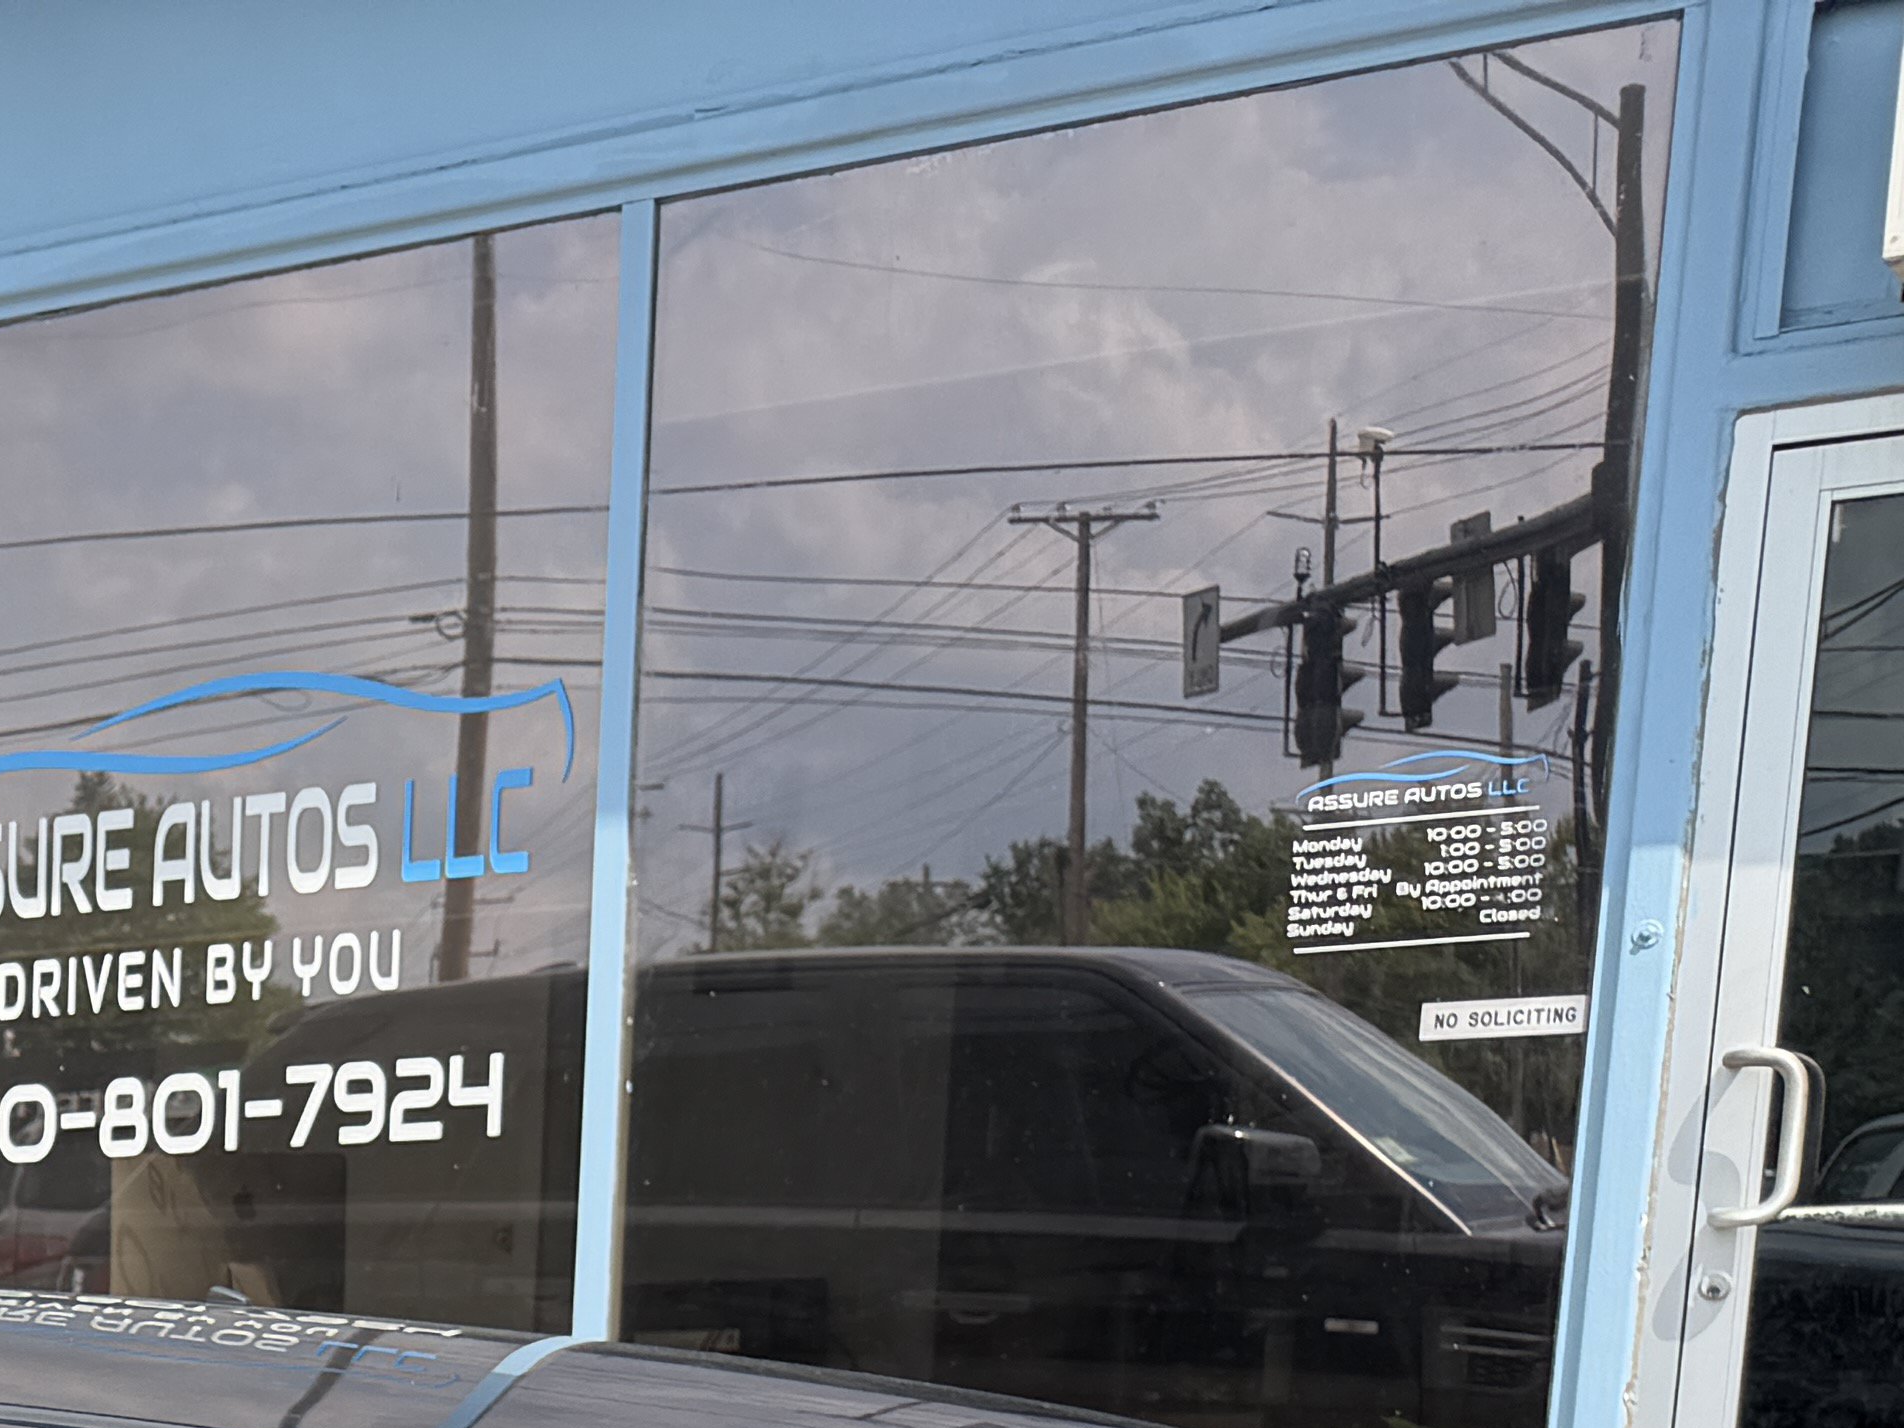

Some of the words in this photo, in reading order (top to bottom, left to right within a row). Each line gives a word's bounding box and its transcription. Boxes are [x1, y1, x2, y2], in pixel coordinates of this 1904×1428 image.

[1308, 790, 1399, 812] ASSURE
[1404, 782, 1482, 804] AUTOS
[1488, 778, 1531, 796] LLC
[152, 782, 378, 906] AUTOS
[402, 767, 533, 882] LLC
[1293, 836, 1362, 854] Monday
[1427, 824, 1482, 842] 10:00
[1500, 819, 1547, 836] 5:00
[1293, 853, 1366, 871] Tuesday
[1440, 841, 1480, 857] 1:00
[1499, 836, 1546, 853] 5:00
[1291, 867, 1392, 887] Wednesday
[1424, 858, 1479, 876] 10:00
[1497, 853, 1545, 870] 5:00
[1288, 902, 1372, 922] Saturday
[1421, 893, 1476, 910] 10:00
[1494, 888, 1542, 904] :00
[1290, 887, 1332, 904] Thur
[1352, 883, 1378, 899] Fri
[1396, 881, 1421, 898] By
[1425, 873, 1543, 895] Appointment
[1287, 921, 1354, 938] Sunday
[1479, 905, 1541, 923] Closed
[206, 940, 272, 1004] BY
[292, 929, 401, 997] YOU
[1434, 1013, 1459, 1030] NO
[1468, 1007, 1577, 1027] SOLICITING
